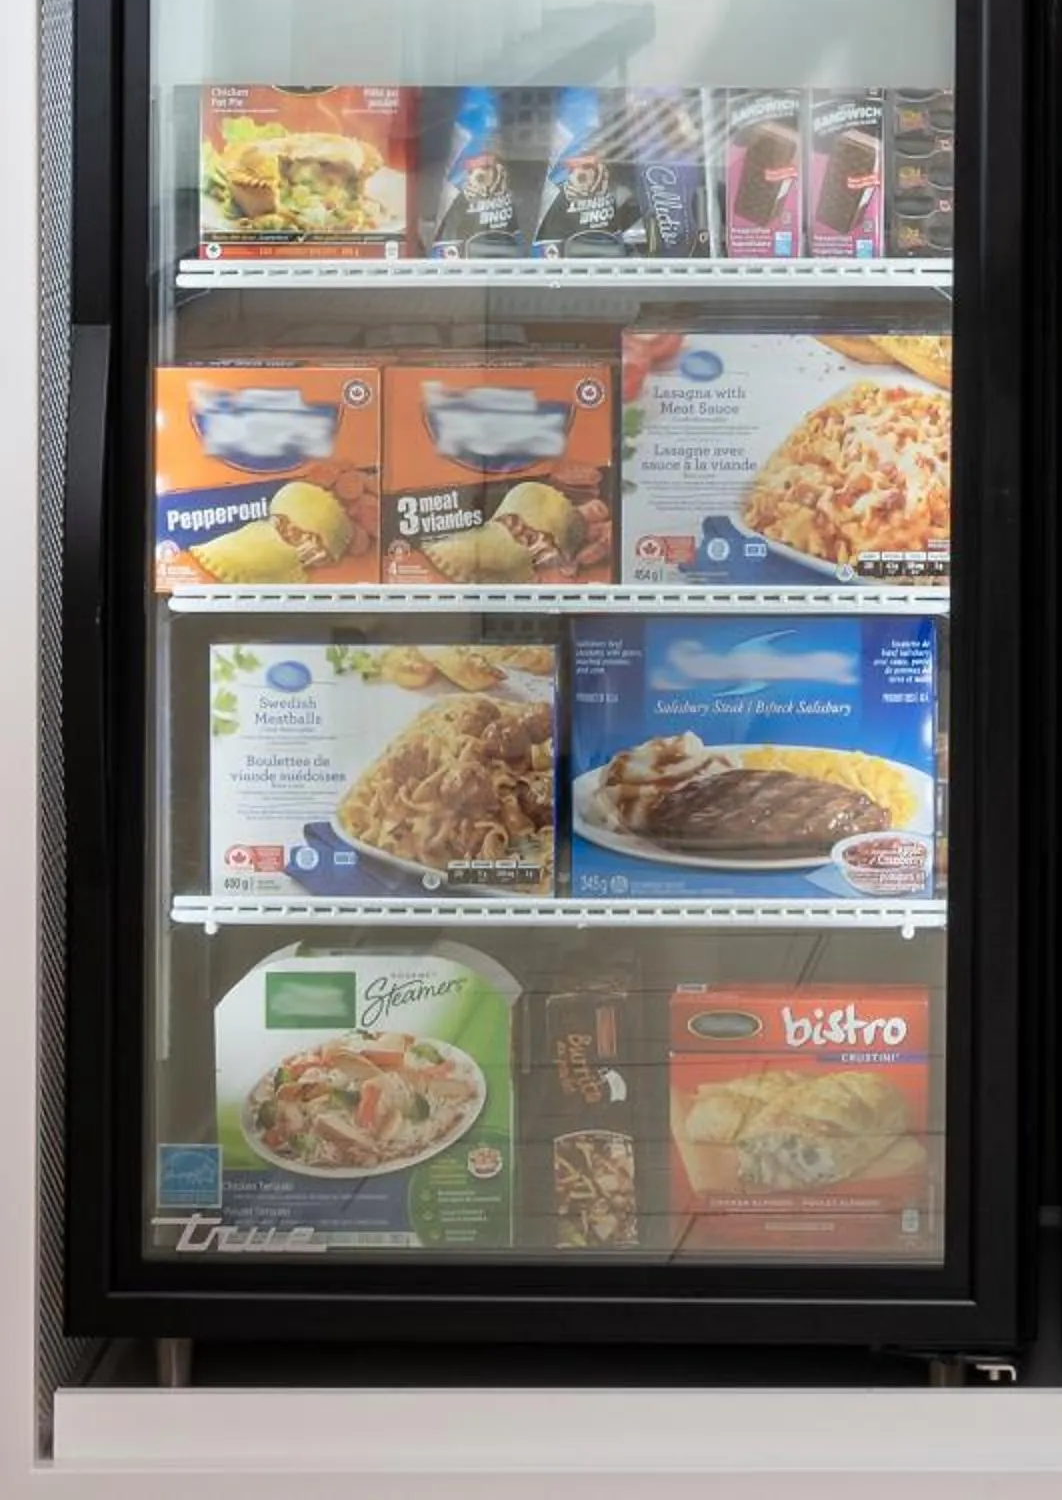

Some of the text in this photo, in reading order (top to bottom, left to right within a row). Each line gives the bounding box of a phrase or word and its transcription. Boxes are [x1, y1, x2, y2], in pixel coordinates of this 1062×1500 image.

[211, 87, 249, 98] Chicken
[730, 100, 798, 126] SANDWICH
[814, 107, 882, 132] SANDWICH
[479, 209, 512, 222] CONE
[579, 207, 613, 223] CONE
[654, 385, 746, 401] Lasagna with
[661, 402, 739, 415] Meat Sauce
[654, 444, 744, 459] Lasagne avec
[641, 462, 679, 471] sauce
[695, 459, 706, 471] la
[711, 460, 757, 471] viande
[166, 498, 269, 532] Pepperoni
[397, 492, 459, 535] 3 meat
[421, 510, 482, 534] viandes
[259, 697, 317, 709] Swedish
[654, 700, 709, 716] Salisbury
[713, 700, 744, 713] Steak
[796, 700, 853, 716] Salisbury
[254, 712, 322, 725] Meatballs
[246, 755, 330, 768] Boulettes de
[231, 768, 346, 782] viande suédoises
[361, 976, 467, 1028] Steamers
[781, 1003, 907, 1047] bistro
[841, 1053, 896, 1063] CRUSTINI
